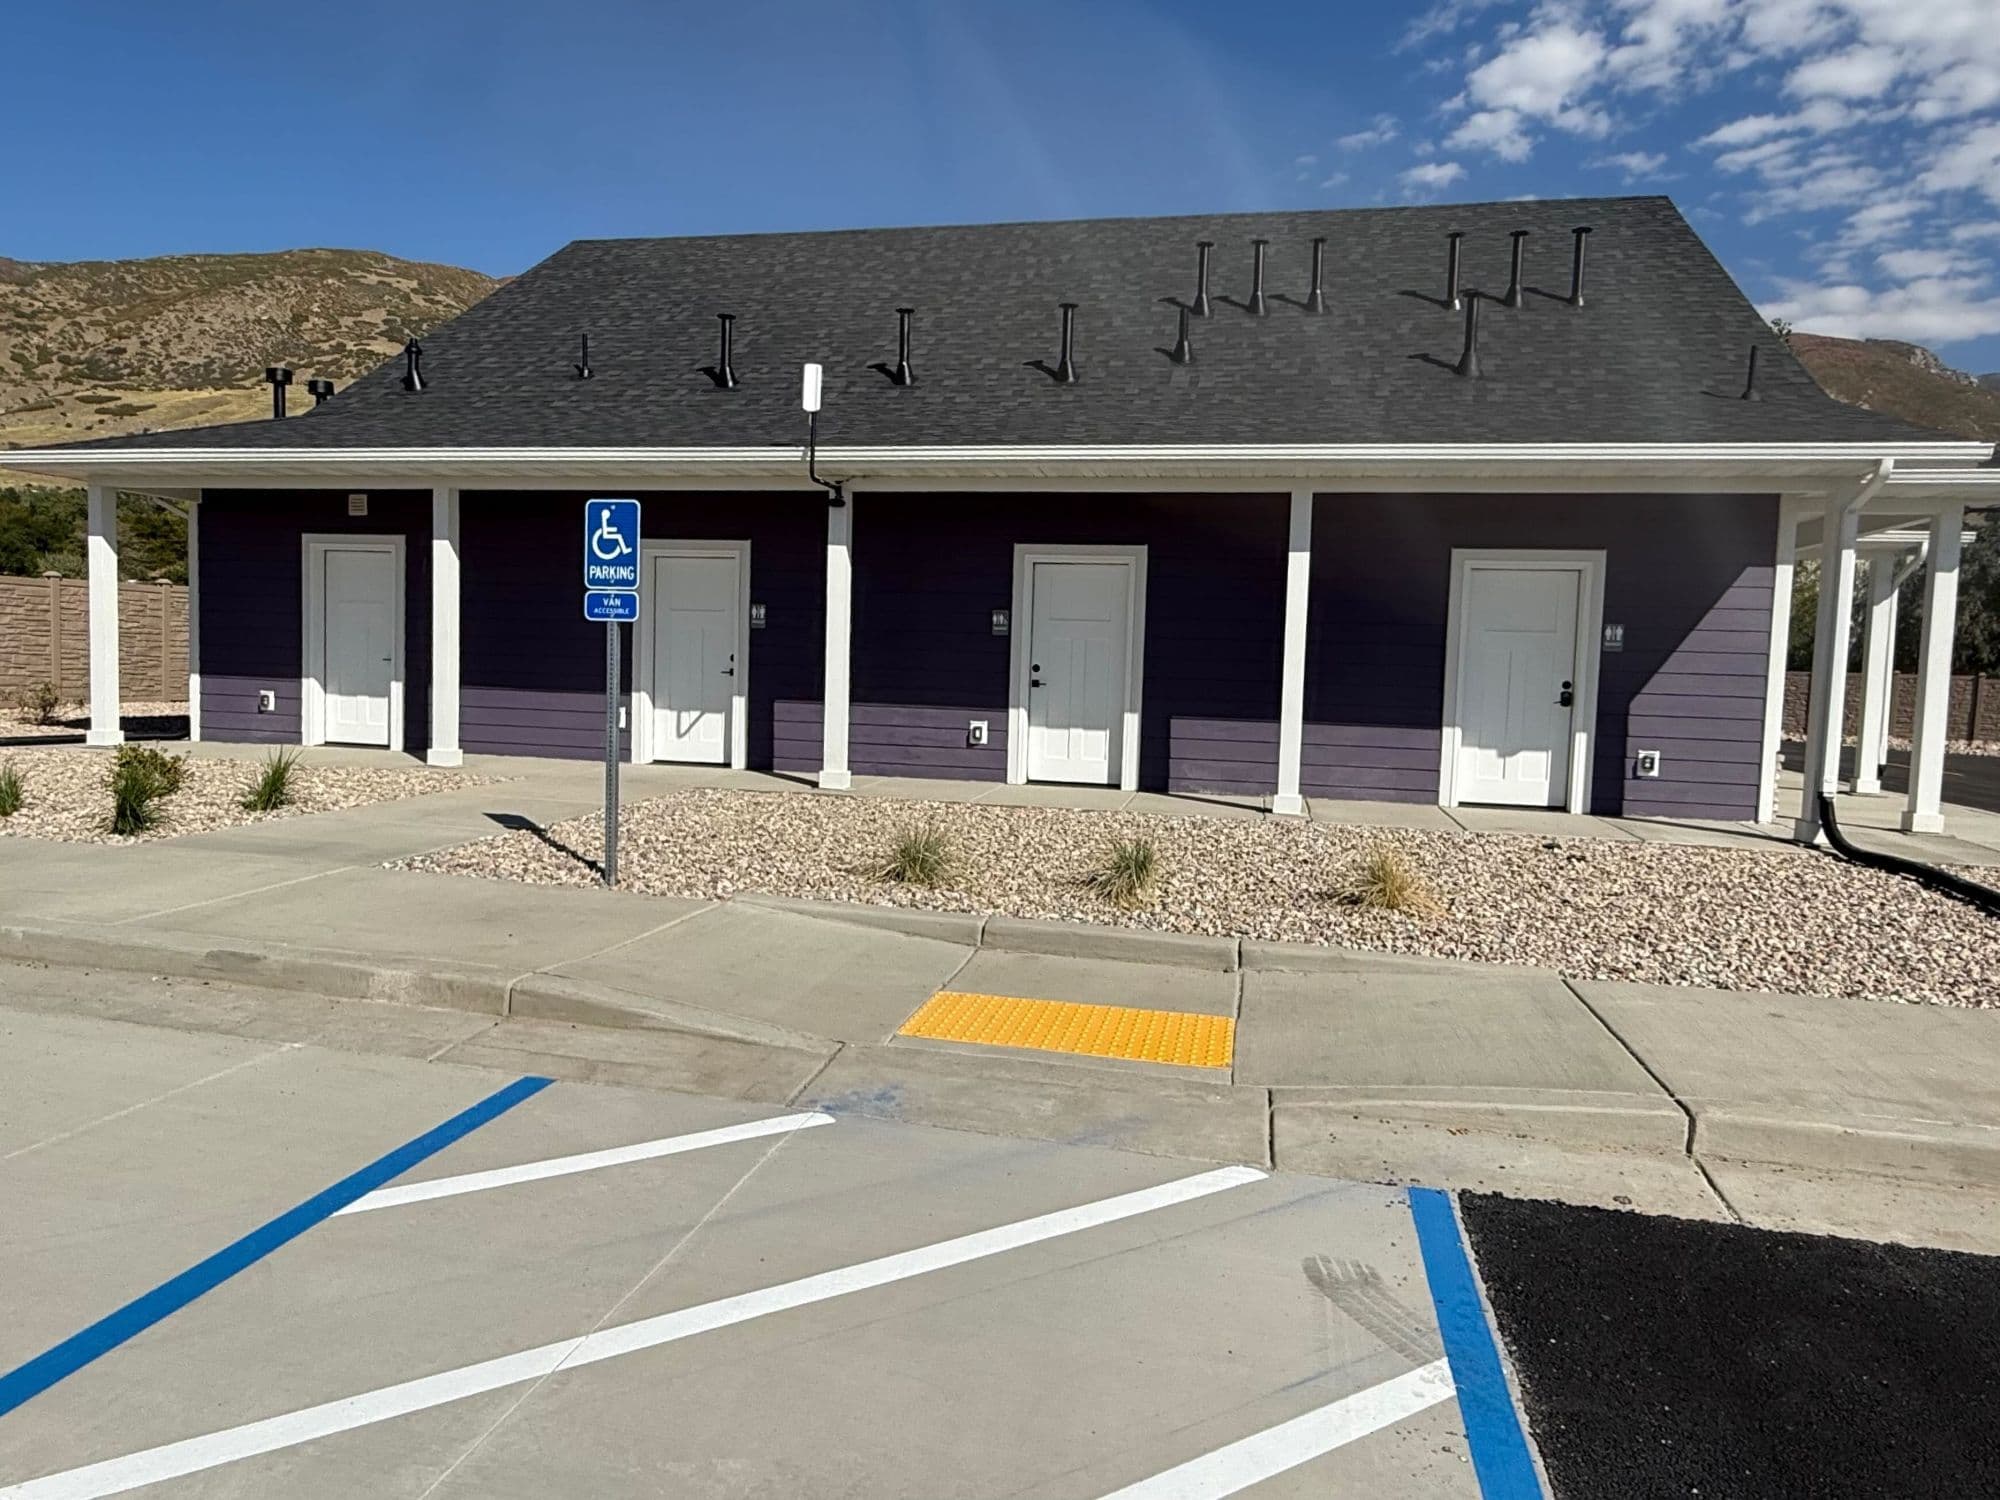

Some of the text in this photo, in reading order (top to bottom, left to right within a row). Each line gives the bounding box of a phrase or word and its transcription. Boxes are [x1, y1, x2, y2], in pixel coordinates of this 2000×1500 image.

[590, 565, 635, 580] PARKING
[602, 597, 621, 607] VAN
[593, 607, 630, 615] ACCESSIBLE
